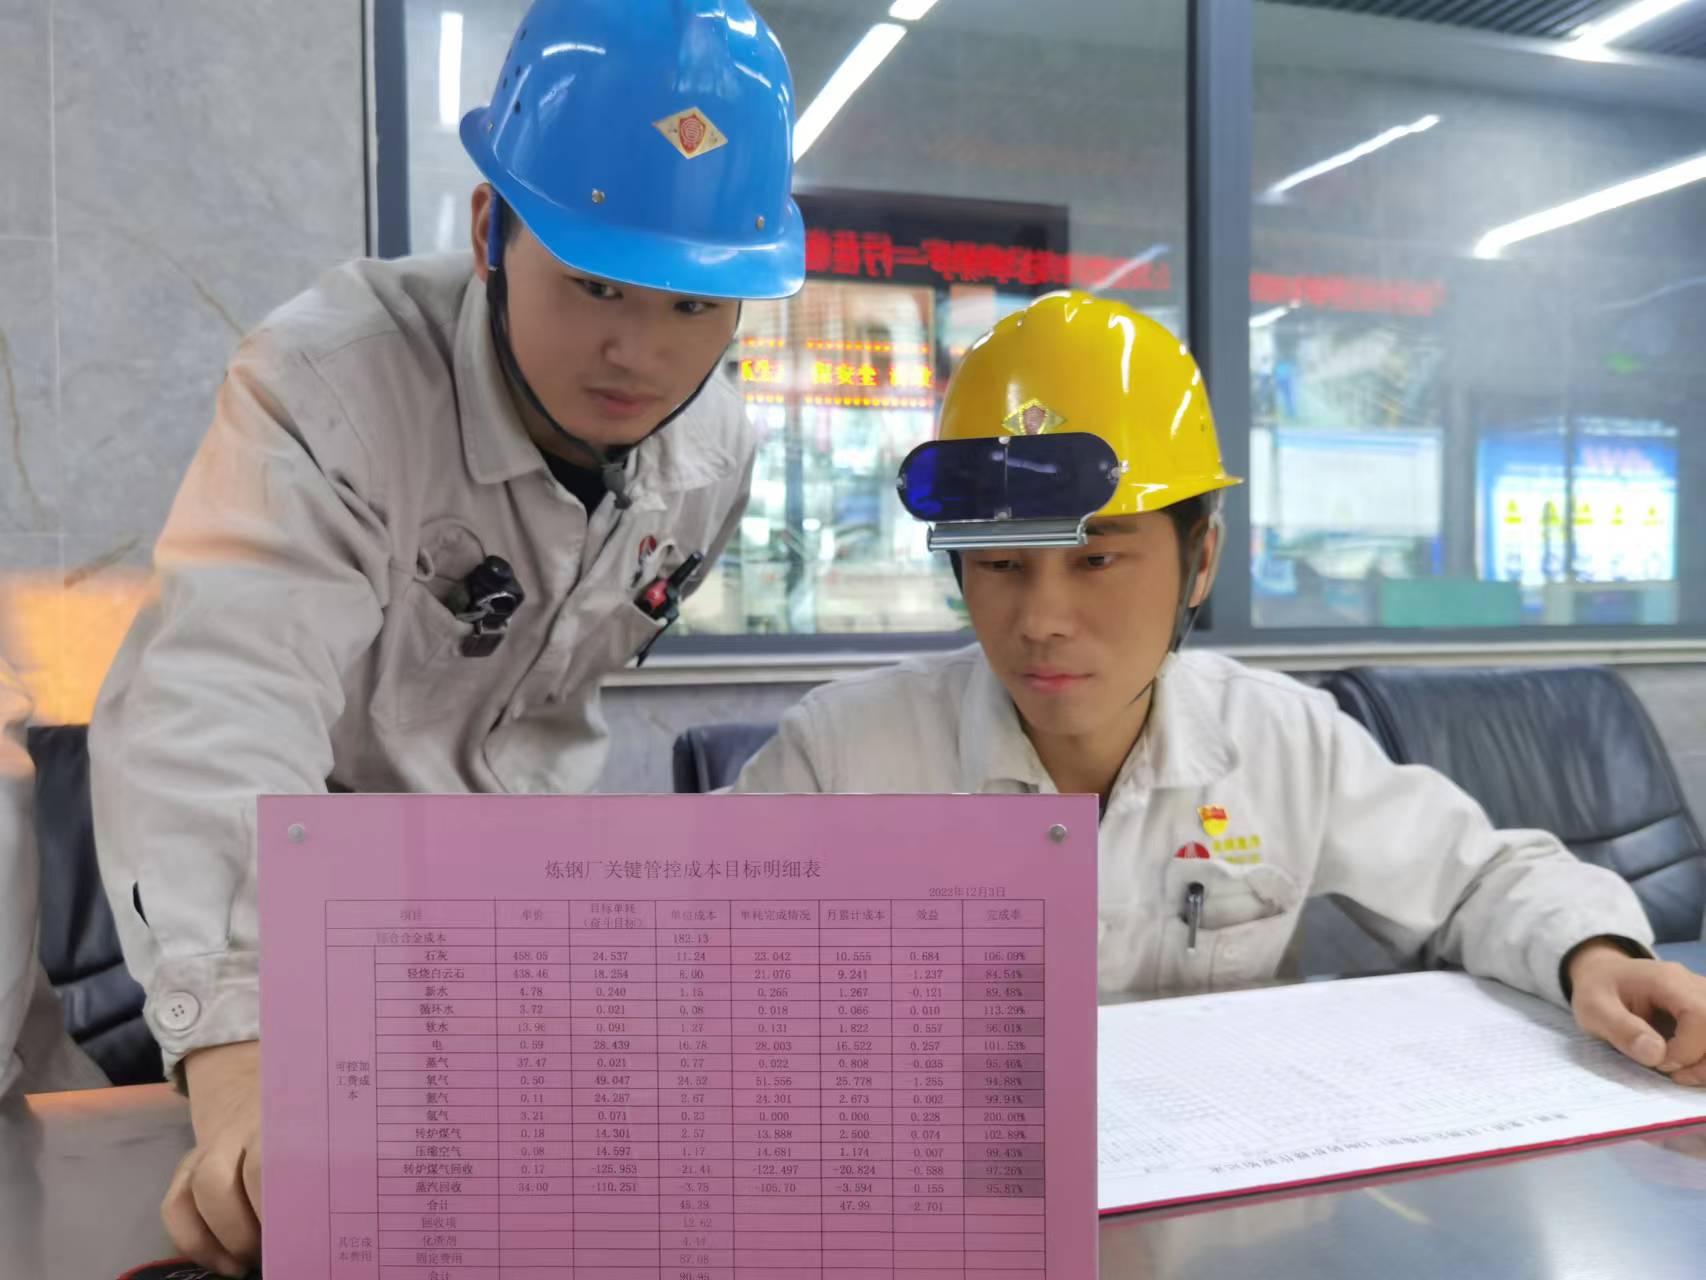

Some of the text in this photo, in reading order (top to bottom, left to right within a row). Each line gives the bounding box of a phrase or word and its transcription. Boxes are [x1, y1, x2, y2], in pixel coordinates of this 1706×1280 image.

[544, 859, 822, 879] 炼钢厂关键管控成本目标明细表
[825, 908, 885, 923] 月累计成本
[672, 933, 709, 945] 182.13
[423, 950, 1027, 961] 石灰 458.05 24.537 11.24 23.042 10.555 0.684 106.09%
[407, 968, 465, 979] 轻烧白云石
[512, 969, 549, 978] 438.46
[593, 969, 629, 979] 18.254
[753, 967, 792, 980] 21.076
[836, 969, 868, 980] 9.241
[423, 986, 449, 997] 新水
[519, 986, 544, 997] 4.78
[595, 987, 627, 997] 0.240
[680, 988, 704, 997] 1.15
[756, 987, 789, 998] 0.265
[839, 985, 869, 998] 1.267
[419, 1004, 1026, 1016] 循环水 3.72 0.021 0.08 0.018 0.066 0.010 113.29%
[595, 1022, 626, 1032] 0.091
[681, 1021, 705, 1032] 1.27
[757, 1024, 788, 1033] 0.131
[839, 1024, 872, 1033] 1.822
[431, 1039, 1027, 1051] 电 0.59 28.439 16.78 28.003 16.522 0.257 101.53%
[516, 1058, 548, 1068] 37.47
[596, 1058, 627, 1067] 0.021
[679, 1058, 705, 1068] 0.77
[757, 1056, 790, 1069] 0.022
[837, 1058, 870, 1068] 0.808
[985, 1059, 1024, 1069] 95.46%
[425, 1075, 449, 1086] 氧气
[520, 1076, 545, 1085] 0.50
[593, 1076, 631, 1085] 49.047
[755, 1076, 793, 1086] 51.556
[835, 1076, 873, 1086] 25.778
[519, 1094, 544, 1103] 0.11
[593, 1091, 631, 1104] 24.287
[679, 1093, 705, 1104] 2.67
[755, 1092, 792, 1104] 24.301
[838, 1094, 870, 1104] 2.673
[519, 1111, 545, 1121] 3.21
[597, 1111, 627, 1121] 0.071
[759, 1112, 790, 1121] 0.000
[838, 1112, 870, 1121] 0.000
[910, 1112, 941, 1122] 0.228
[415, 1128, 462, 1139] 转炉煤气
[520, 1129, 545, 1139] 0.18
[595, 1129, 631, 1138] 14.301
[680, 1128, 705, 1140] 2.57
[757, 1128, 793, 1139] 13.888
[839, 1129, 871, 1139] 2.500
[910, 1130, 942, 1141] 0.074
[415, 1145, 463, 1157] 压缩空气
[520, 1147, 545, 1156] 0.08
[596, 1146, 632, 1157] 14.597
[682, 1145, 707, 1157] 1.17
[757, 1147, 792, 1158] 14.681
[839, 1148, 870, 1157] 1.174
[985, 1148, 1024, 1157] 99.43%
[402, 1164, 473, 1175] 转炉煤气回收
[520, 1164, 545, 1174] 0.17
[591, 1164, 638, 1174] -125.953
[833, 1165, 876, 1176] -20.824
[908, 1166, 945, 1176] -0.588
[985, 1166, 1024, 1176] 97.26%
[415, 1180, 463, 1193] 蒸汽回收
[836, 1183, 873, 1192] -3.594
[985, 1184, 1024, 1194] 95.87%
[426, 1199, 449, 1211] 合计
[839, 1200, 871, 1210] 47.99
[415, 1252, 463, 1264] 固定费用
